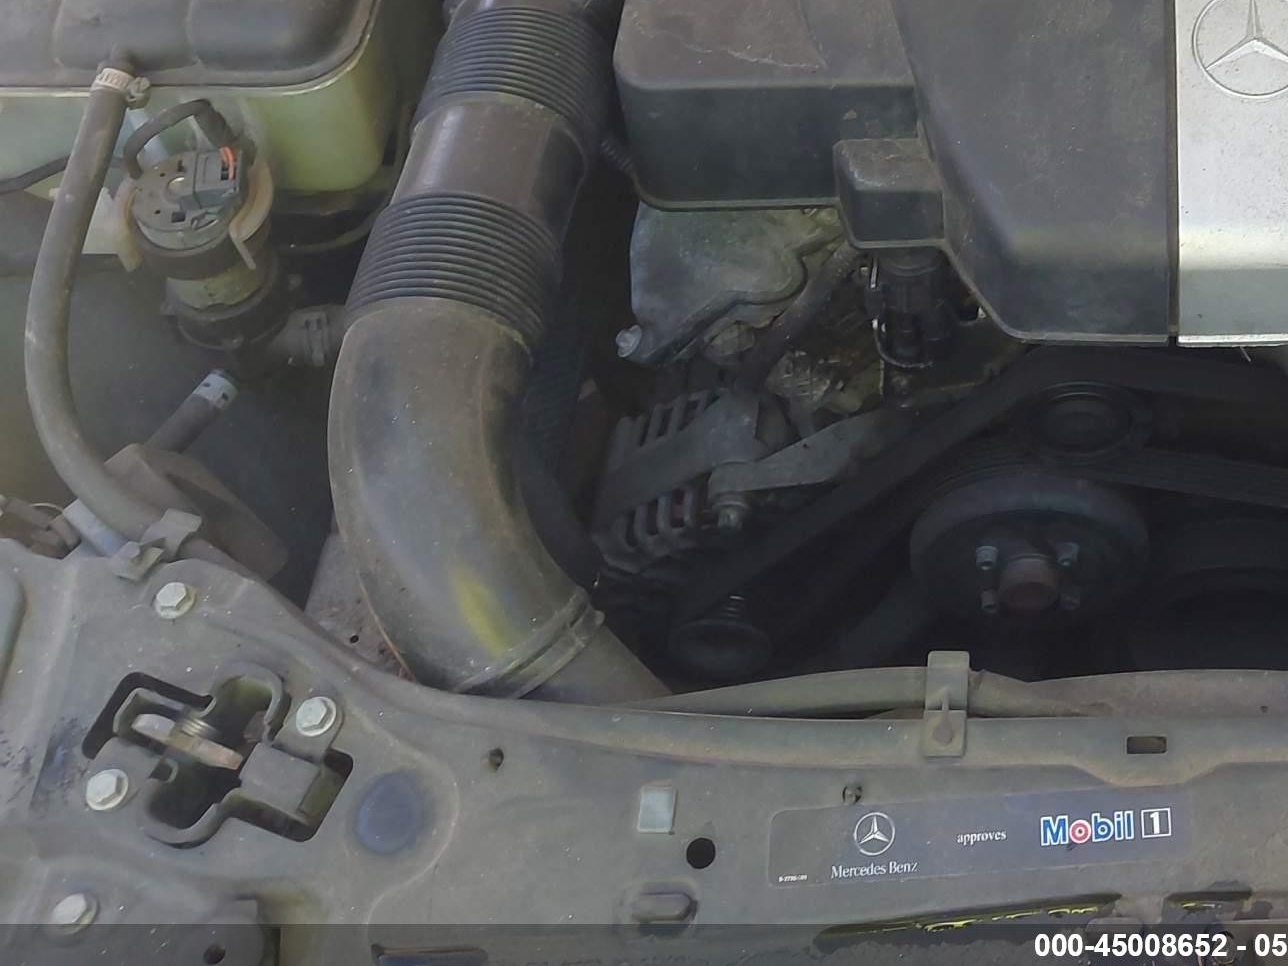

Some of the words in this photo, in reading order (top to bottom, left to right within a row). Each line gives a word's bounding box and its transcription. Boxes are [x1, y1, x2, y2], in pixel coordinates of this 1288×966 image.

[957, 829, 1007, 846] approves
[1040, 810, 1135, 846] Mobil
[831, 862, 887, 879] Mercedes
[889, 860, 918, 874] Benz
